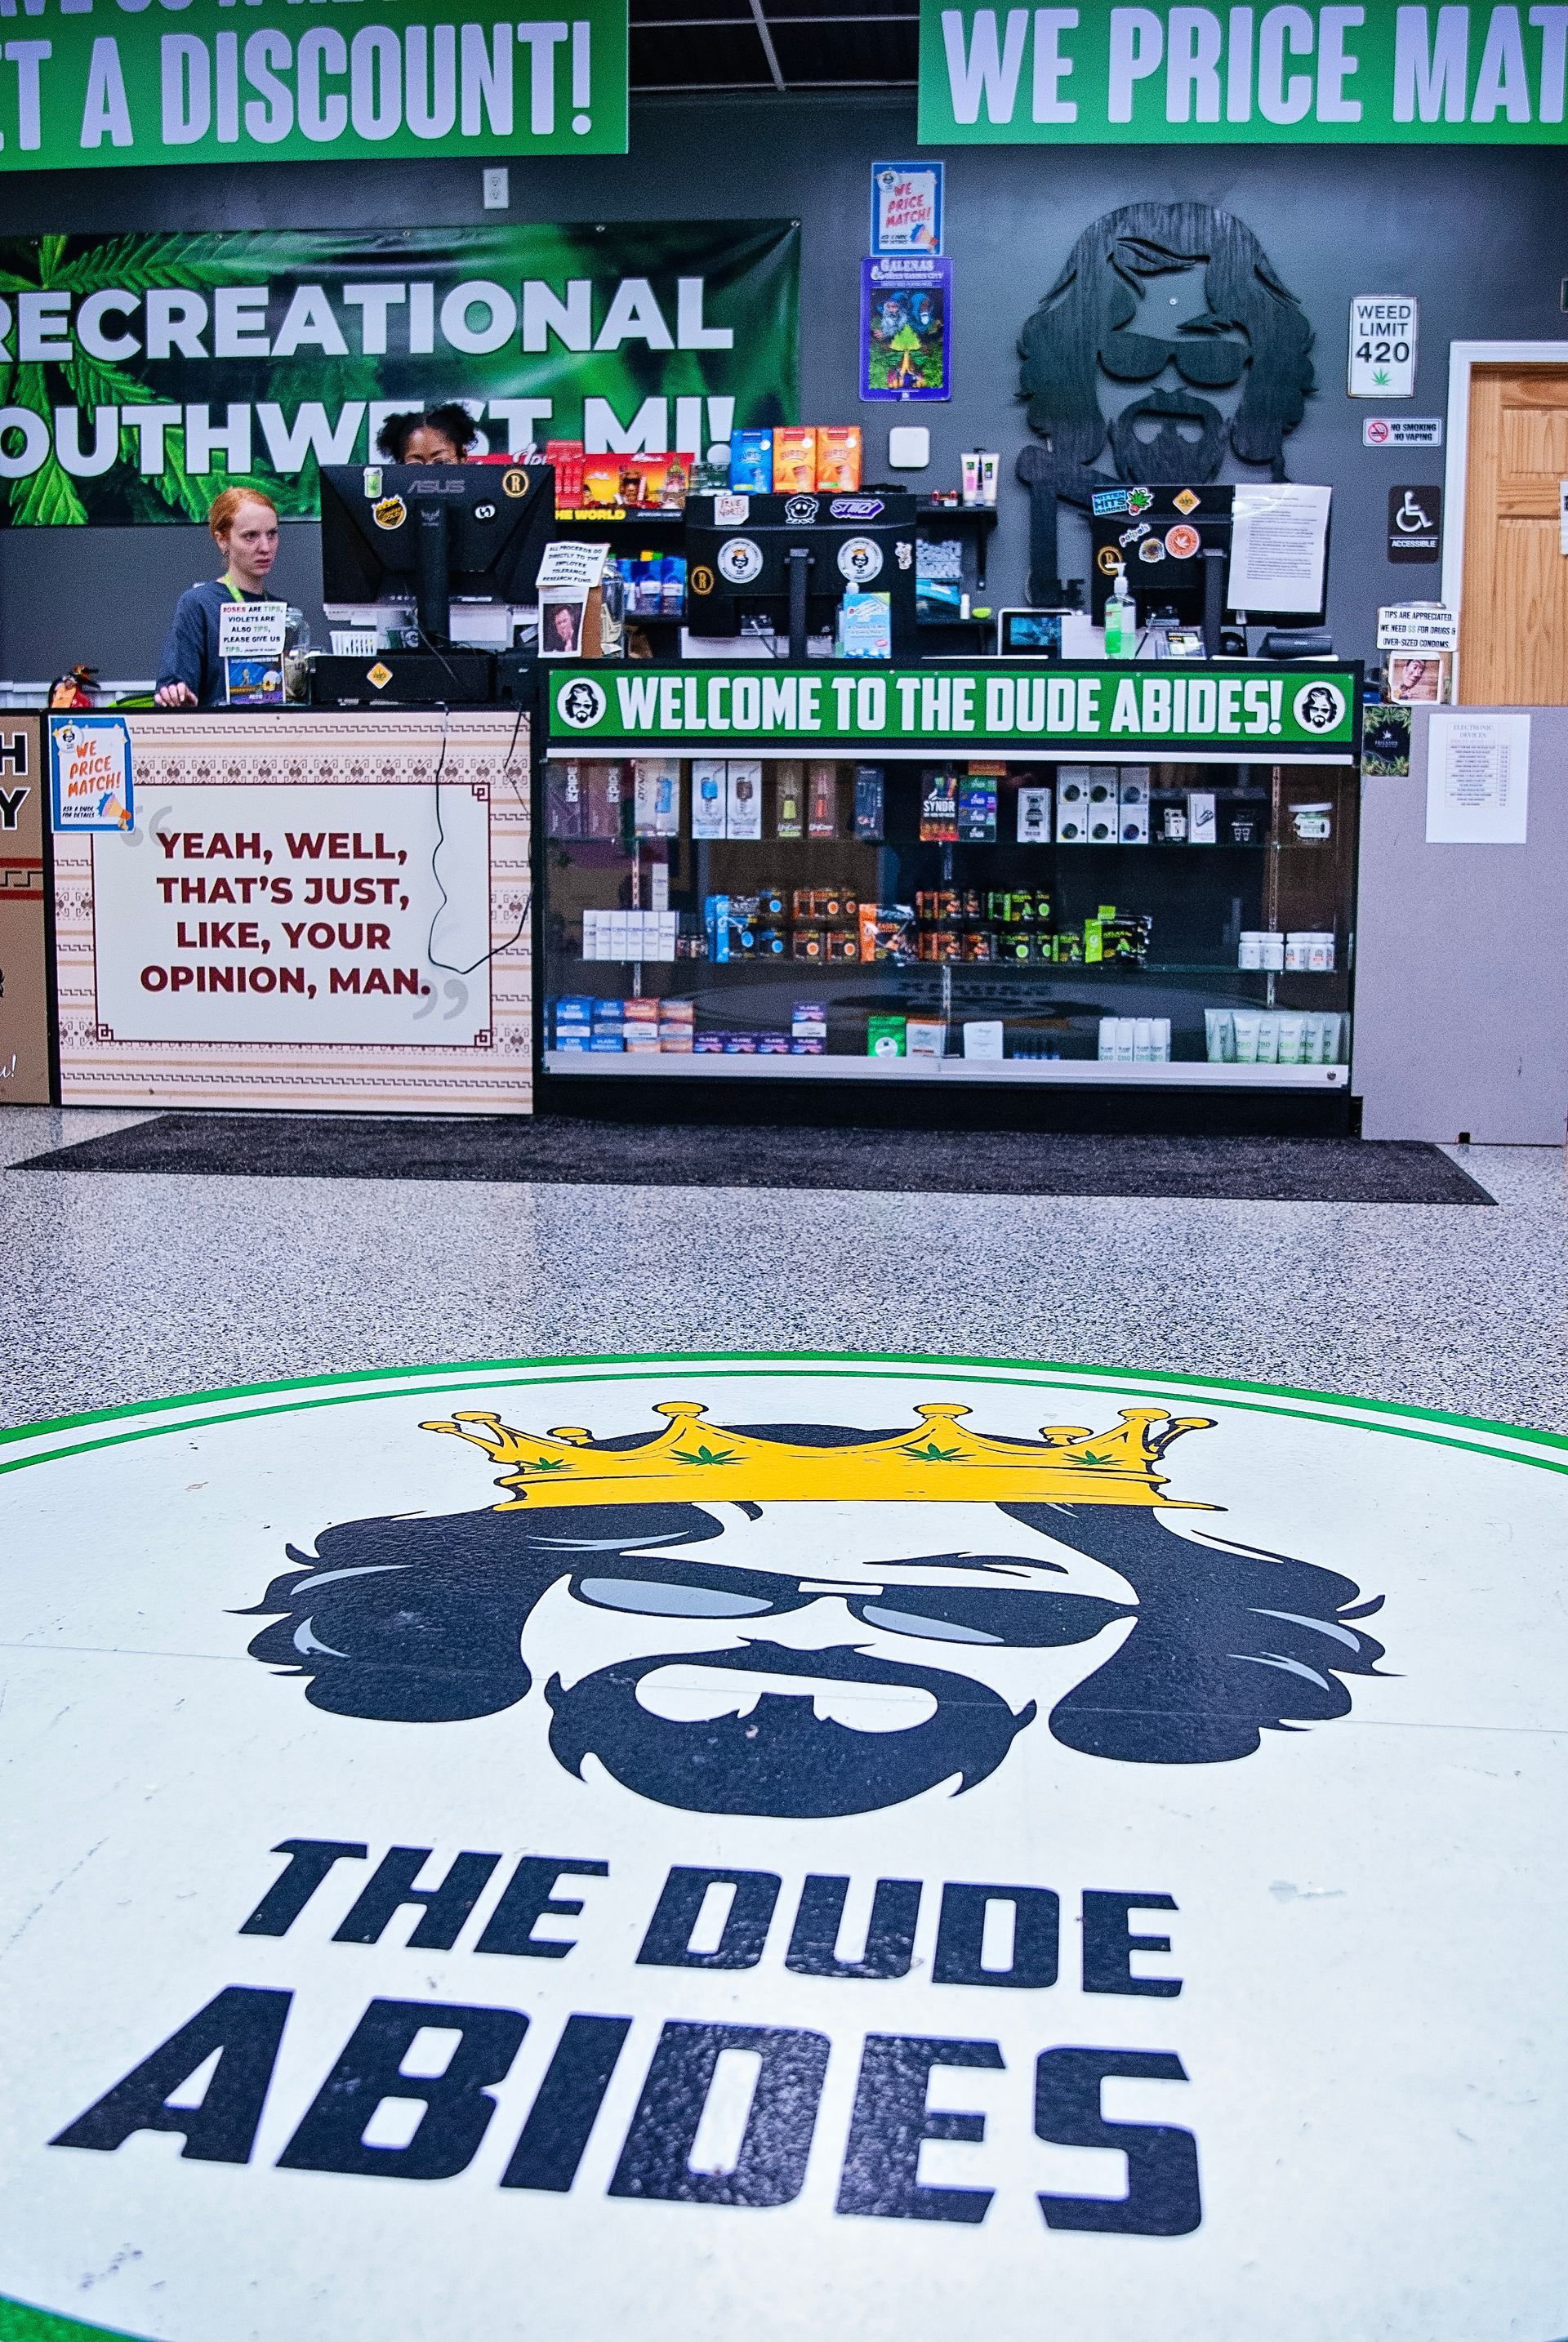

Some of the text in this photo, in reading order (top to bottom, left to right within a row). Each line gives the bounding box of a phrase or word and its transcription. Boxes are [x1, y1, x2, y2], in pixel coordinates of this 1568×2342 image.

[941, 8, 1079, 124] WE
[1108, 6, 1366, 125] PRICE
[81, 36, 134, 149] A
[161, 20, 592, 145] DISCOUNT!
[894, 182, 912, 196] WE
[888, 194, 924, 213] PRICE
[886, 207, 931, 228] MATCH!
[0, 277, 733, 362] ECREATIONAL
[1356, 305, 1411, 319] WEED
[1359, 323, 1409, 336] LIMIT
[1355, 341, 1410, 363] 420
[584, 397, 735, 465] MI!
[1402, 424, 1437, 432] SMOKING
[1405, 433, 1432, 441] VAPING
[408, 480, 466, 493] ASUS
[1094, 492, 1125, 500] MITTEN
[1094, 496, 1126, 508] HITS
[555, 510, 573, 520] HE
[575, 510, 626, 520] WORLD
[1095, 505, 1127, 514] HARDER
[559, 545, 592, 554] PROCEEDS
[1392, 539, 1436, 548] ACCESSIBLE
[1384, 611, 1397, 619] TIPS
[1412, 612, 1453, 621] APPRECIATED.
[1380, 624, 1390, 633] WE
[1391, 625, 1406, 633] NEED
[1417, 626, 1429, 634] FOR
[1430, 626, 1450, 634] DRUGS
[1451, 627, 1456, 635] &
[1383, 638, 1450, 648] OVER-SIZED CONDOMS.
[616, 677, 1284, 735] WELCOME TO THE DUDE ABIDES!
[76, 740, 97, 758] WE
[69, 755, 112, 779] PRICE
[68, 771, 121, 798] MATCH!
[156, 832, 407, 866] YEAH, WELL,
[156, 876, 410, 911] THAT'S JUST,
[176, 922, 390, 954] LIKE, YOUR
[140, 966, 431, 1000] OPINION, MAN.
[237, 1837, 1183, 1997] THE DUDE
[47, 1984, 1205, 2237] ABIDES
